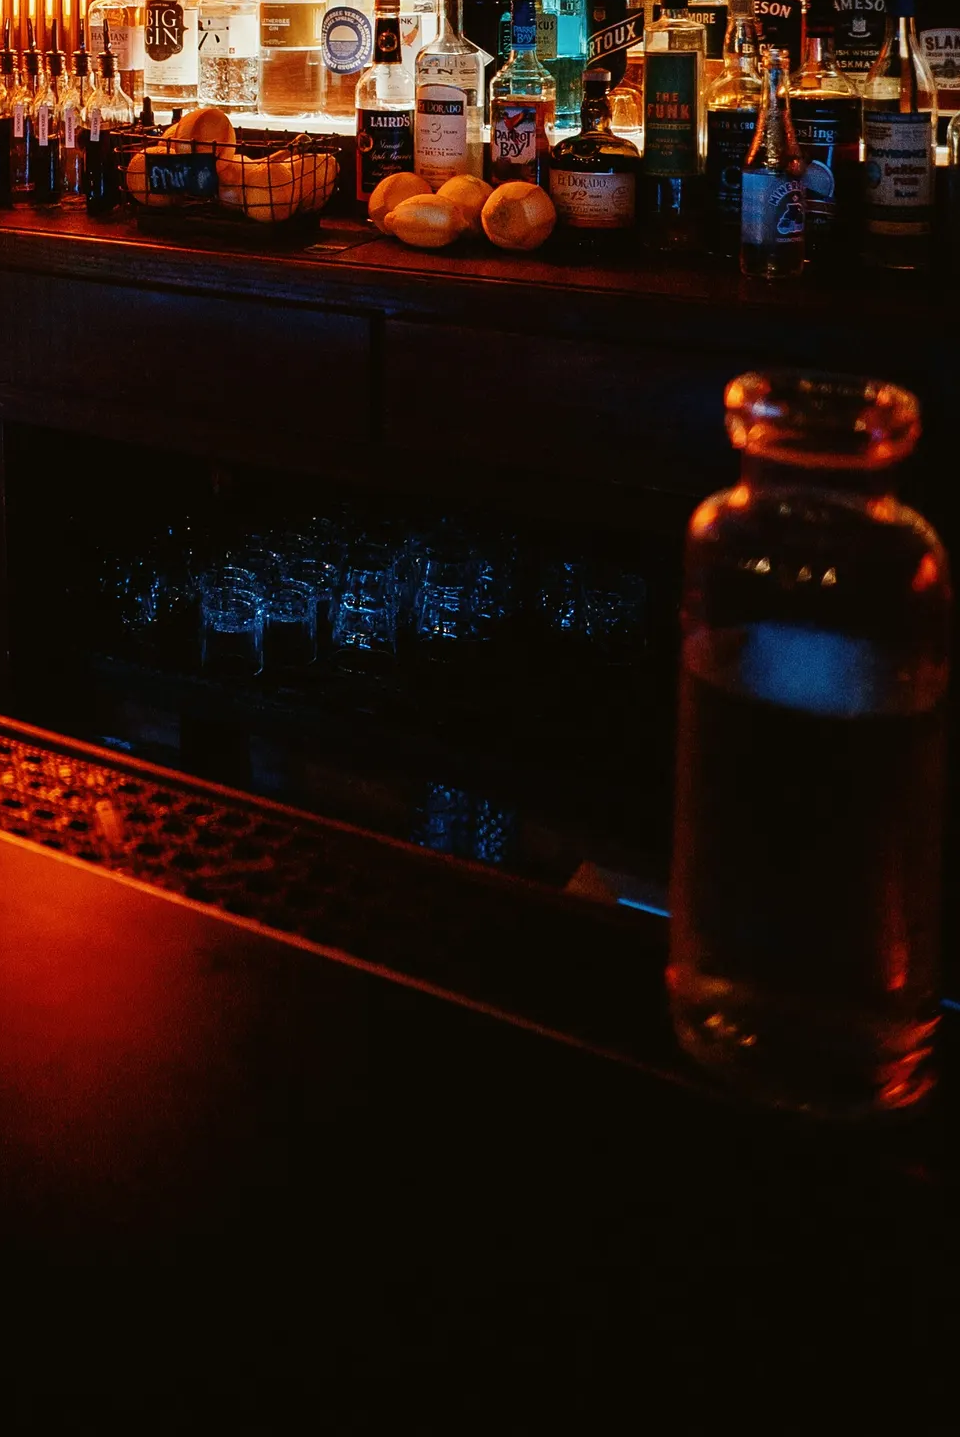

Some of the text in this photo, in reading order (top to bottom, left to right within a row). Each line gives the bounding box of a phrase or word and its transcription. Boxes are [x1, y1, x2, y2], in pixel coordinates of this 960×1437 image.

[754, 1, 792, 18] ESON
[146, 9, 177, 28] BIG
[688, 13, 716, 24] MORE
[145, 27, 179, 46] GIN
[589, 22, 637, 58] RTOUX
[656, 92, 679, 103] THE
[428, 102, 461, 115] DORADO
[647, 104, 691, 120] FUNK
[370, 114, 410, 128] LAIRD'S
[740, 122, 756, 130] CRO
[494, 129, 533, 147] PARROT
[797, 125, 838, 143] osling
[500, 141, 526, 158] BAY
[568, 175, 607, 189] DORADO
[570, 190, 587, 201] 12
